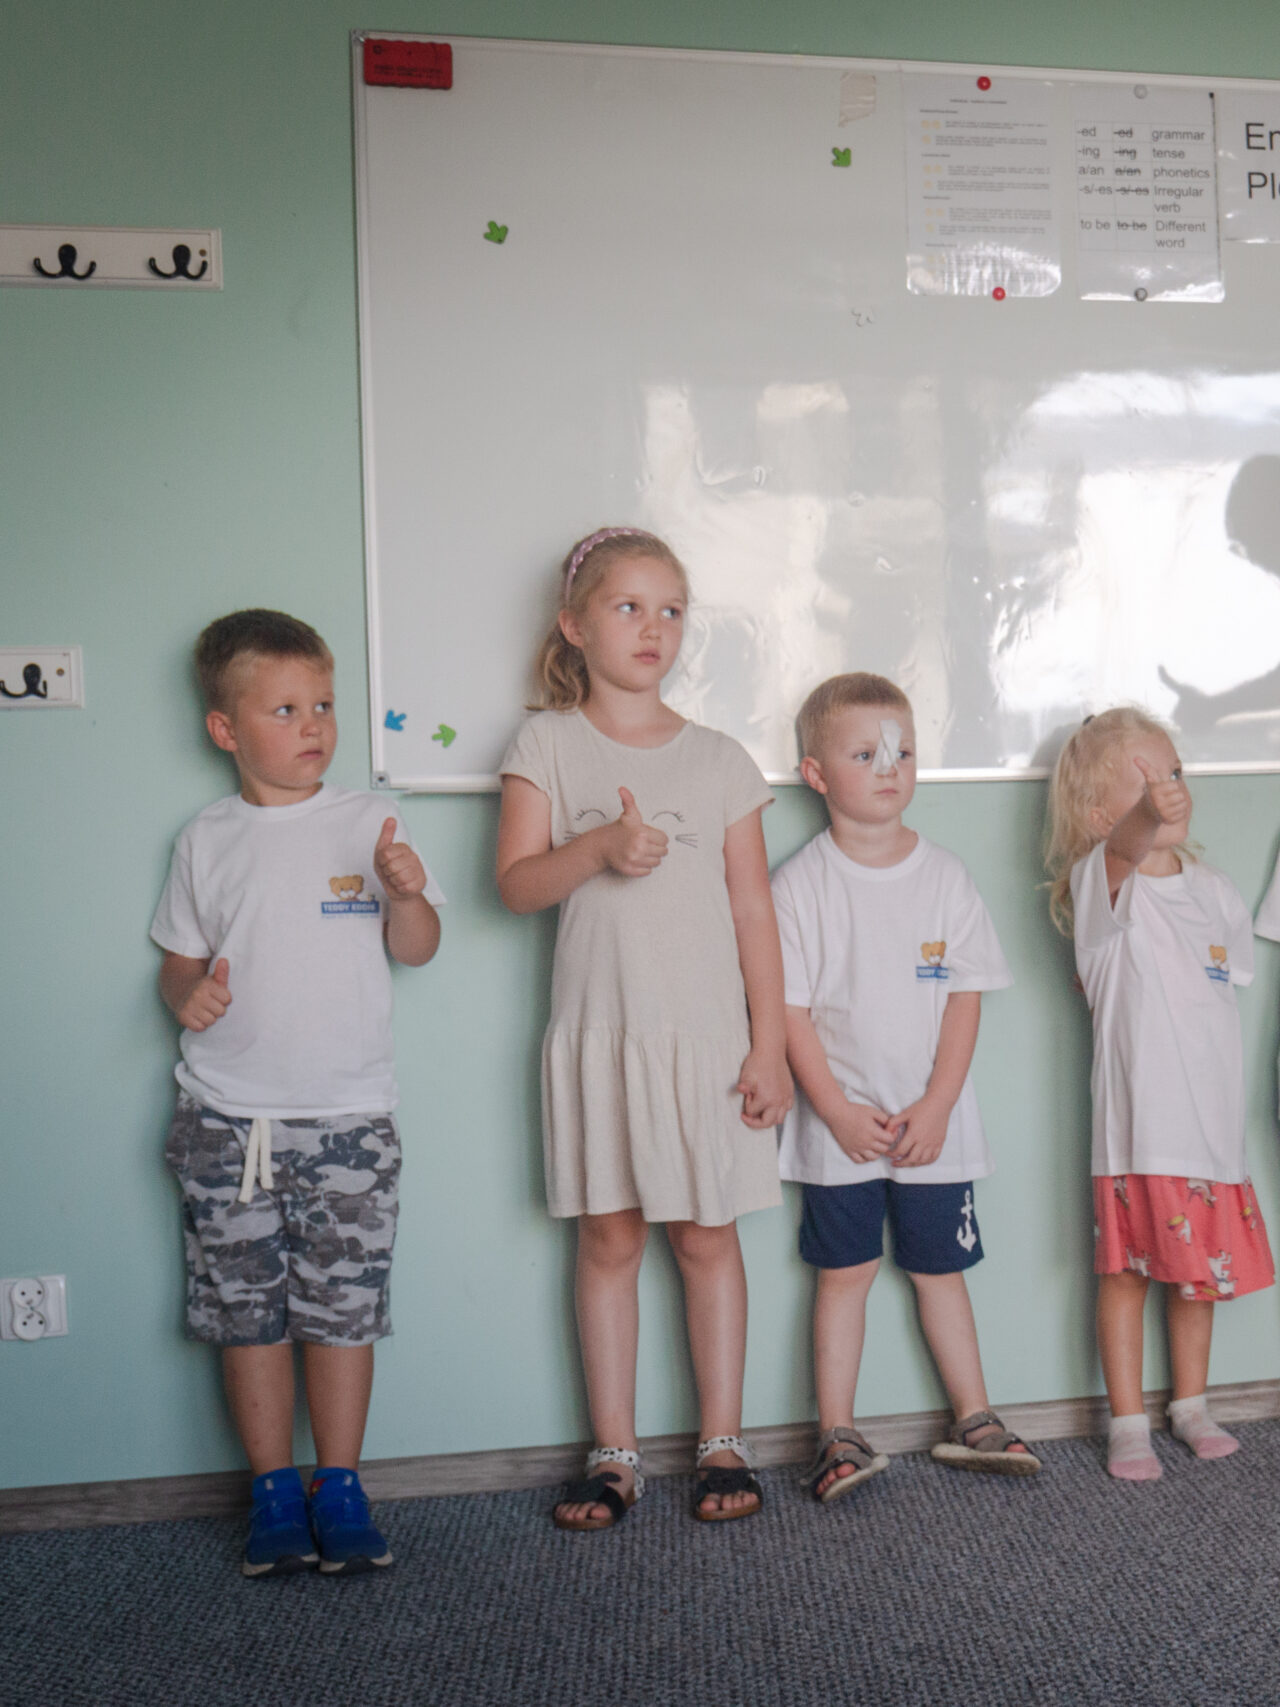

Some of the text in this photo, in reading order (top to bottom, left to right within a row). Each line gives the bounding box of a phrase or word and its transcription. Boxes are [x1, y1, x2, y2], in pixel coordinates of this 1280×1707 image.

[1076, 126, 1096, 138] -ed
[1151, 131, 1205, 142] grammar
[1077, 145, 1101, 159] -ing
[1152, 148, 1186, 160] tense
[1078, 165, 1105, 175] a/an
[1153, 168, 1210, 180] phonetics
[1154, 186, 1204, 199] Irregular
[1154, 201, 1181, 213] verb
[1080, 219, 1092, 230] to
[1095, 219, 1111, 230] be
[1155, 220, 1207, 232] Different
[1155, 238, 1185, 249] word
